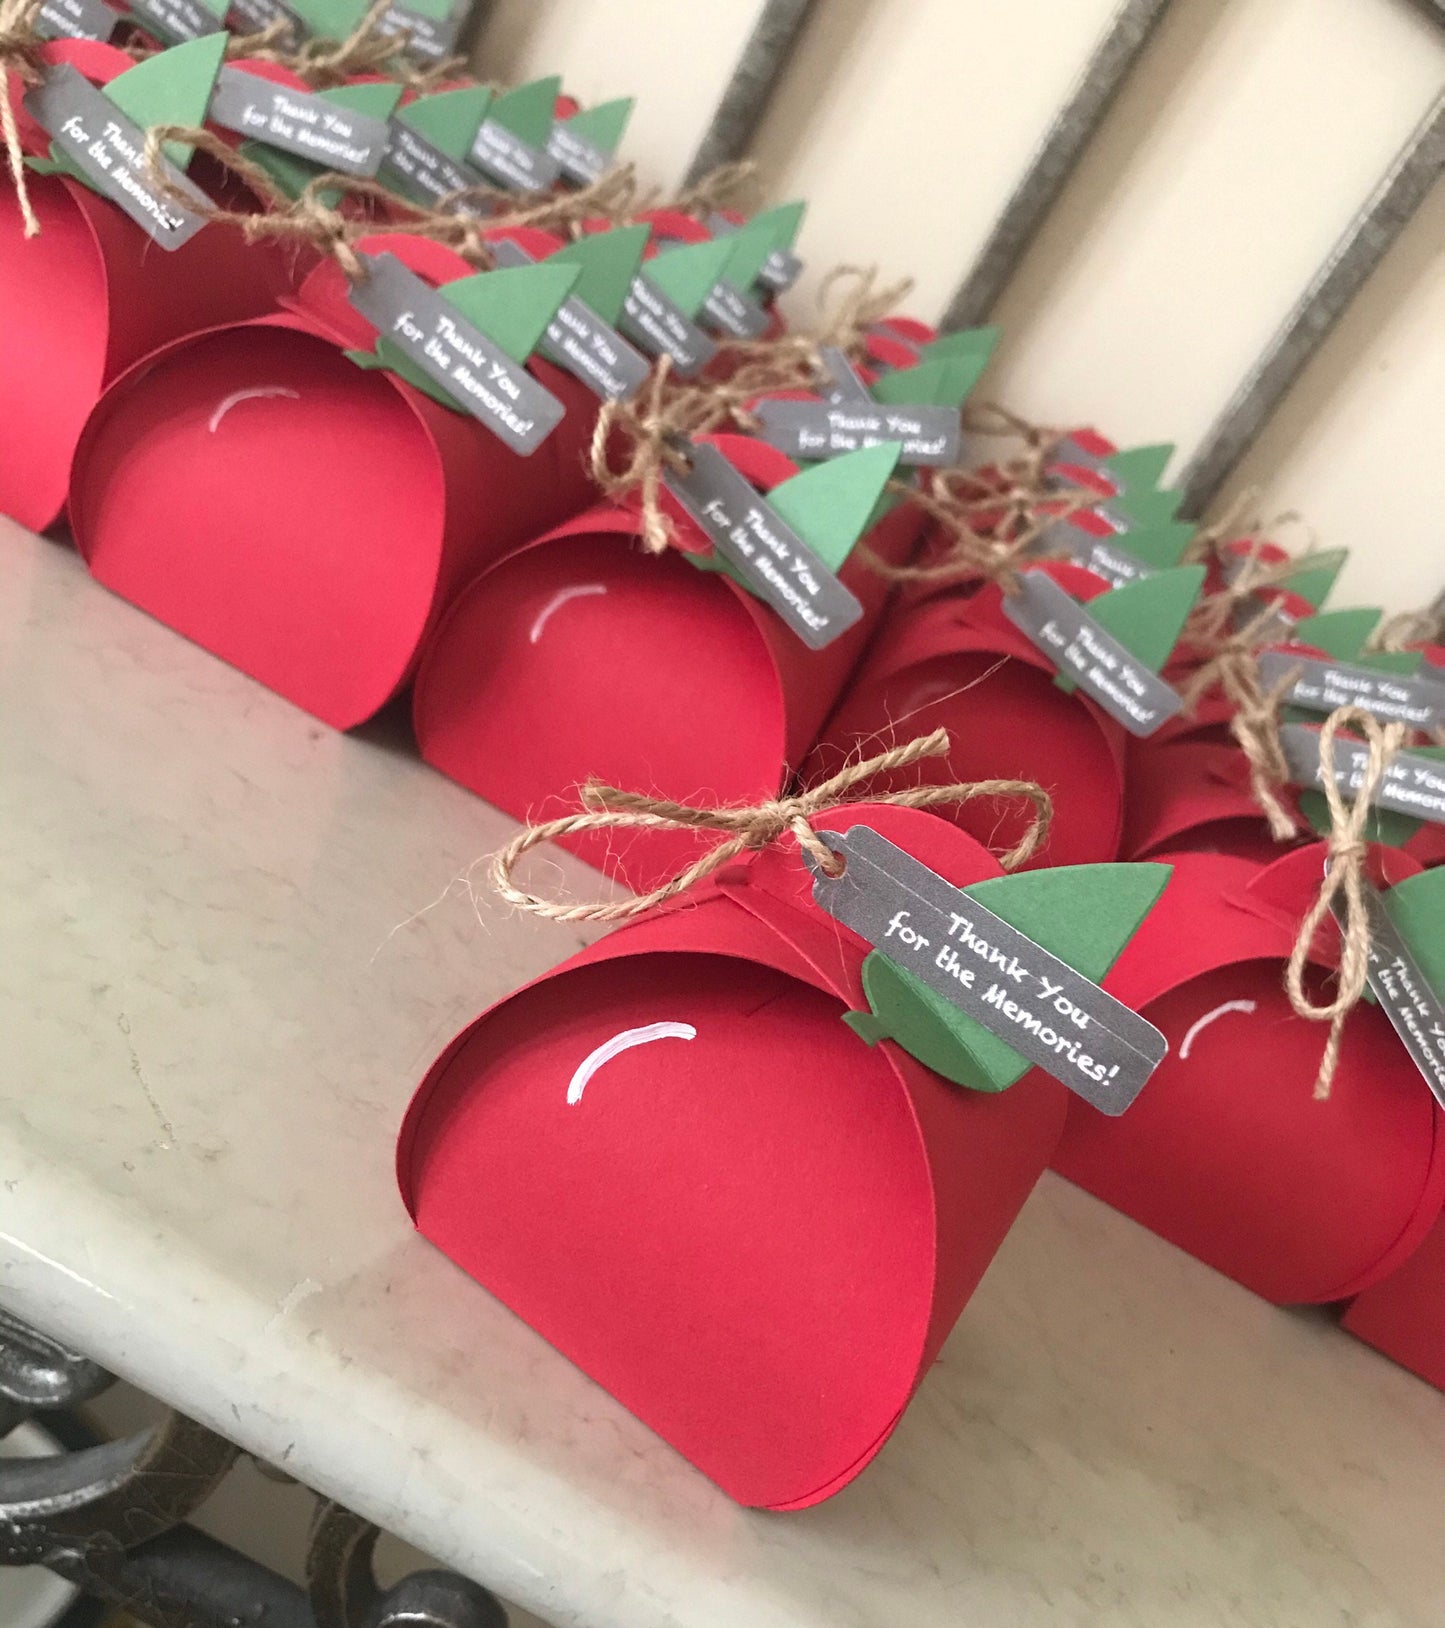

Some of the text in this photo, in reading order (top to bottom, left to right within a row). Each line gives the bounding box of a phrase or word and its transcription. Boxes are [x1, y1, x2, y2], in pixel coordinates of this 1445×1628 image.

[61, 116, 90, 143] for
[88, 140, 113, 170] the
[322, 113, 353, 139] You
[393, 311, 535, 437] for the Memories!
[436, 313, 521, 400] Thank You
[886, 414, 922, 435] You
[702, 499, 731, 528] for
[729, 527, 754, 558] the
[744, 508, 821, 596] Thank You
[883, 910, 1121, 1088] for the Memories!
[948, 911, 1092, 1031] Thank You
[1377, 968, 1399, 1001] the
[1391, 955, 1431, 1017] Thank
